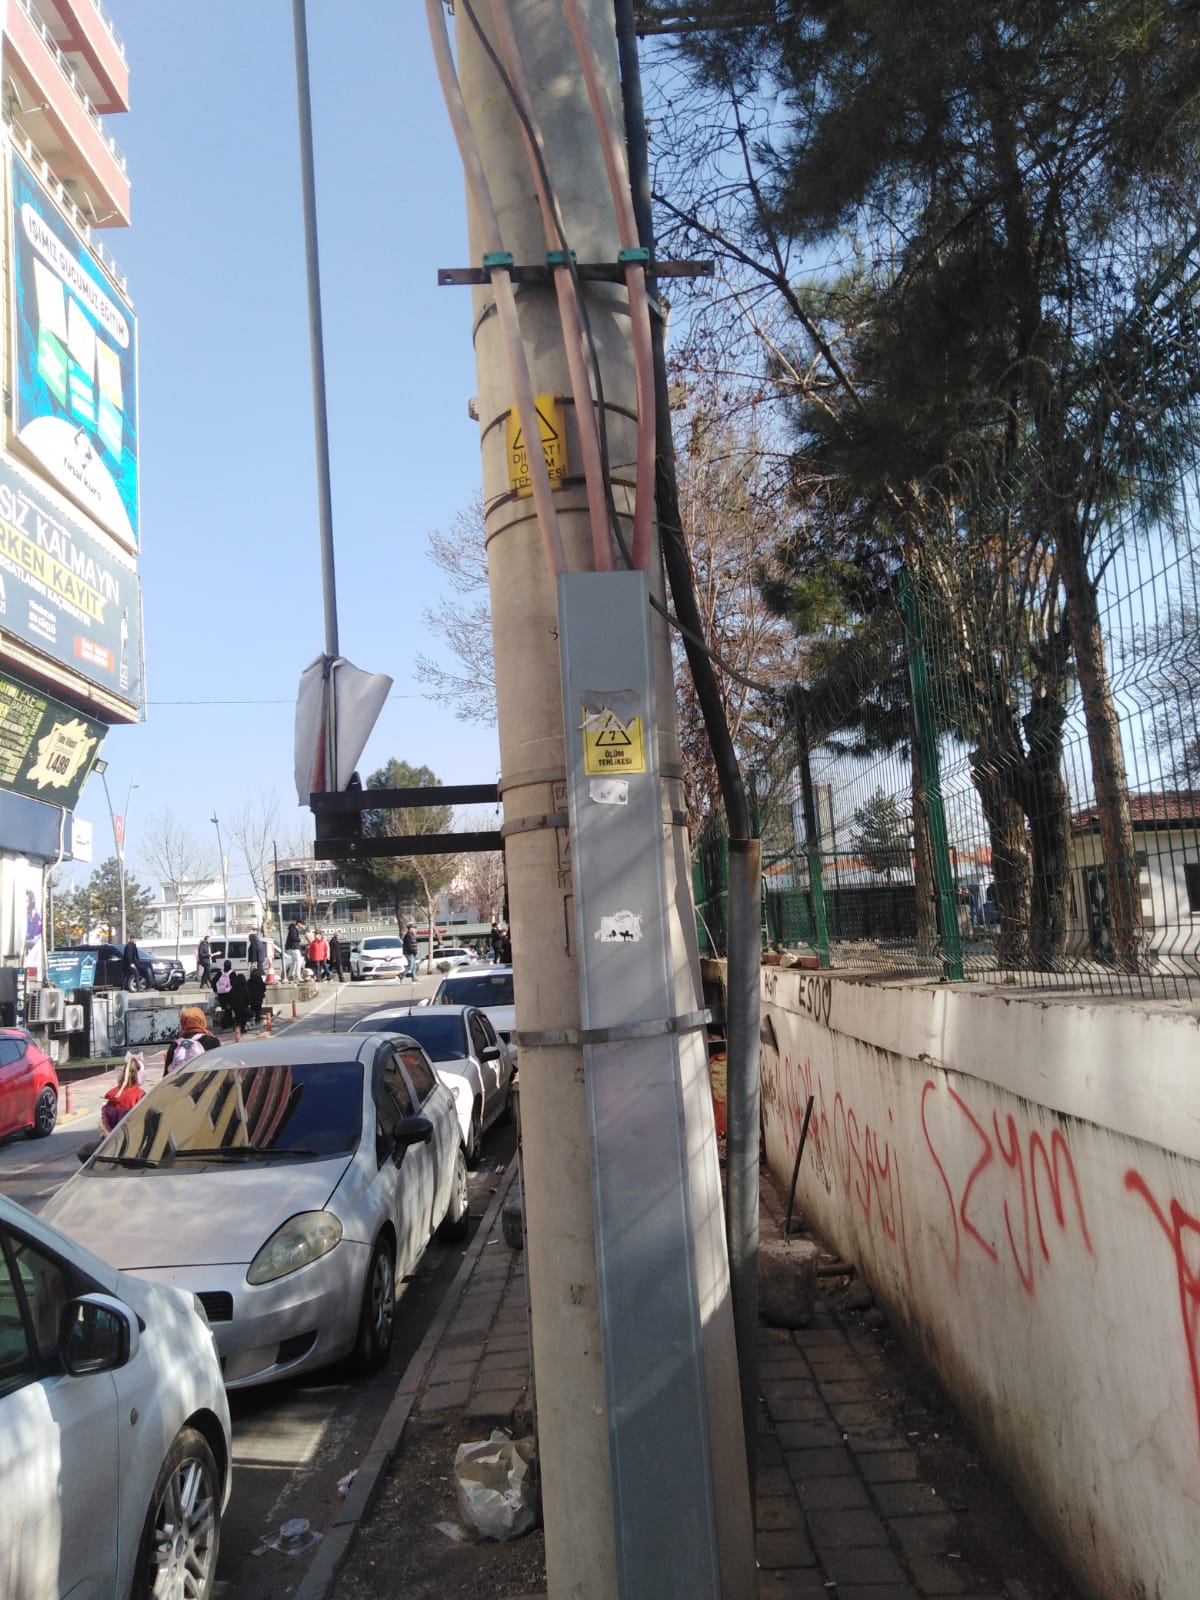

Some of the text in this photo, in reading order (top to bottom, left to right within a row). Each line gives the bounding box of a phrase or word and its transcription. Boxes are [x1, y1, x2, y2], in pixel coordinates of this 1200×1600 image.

[36, 513, 119, 607] KALMAYIN
[53, 563, 99, 615] KAYIT
[604, 749, 625, 758] ÖLÜM
